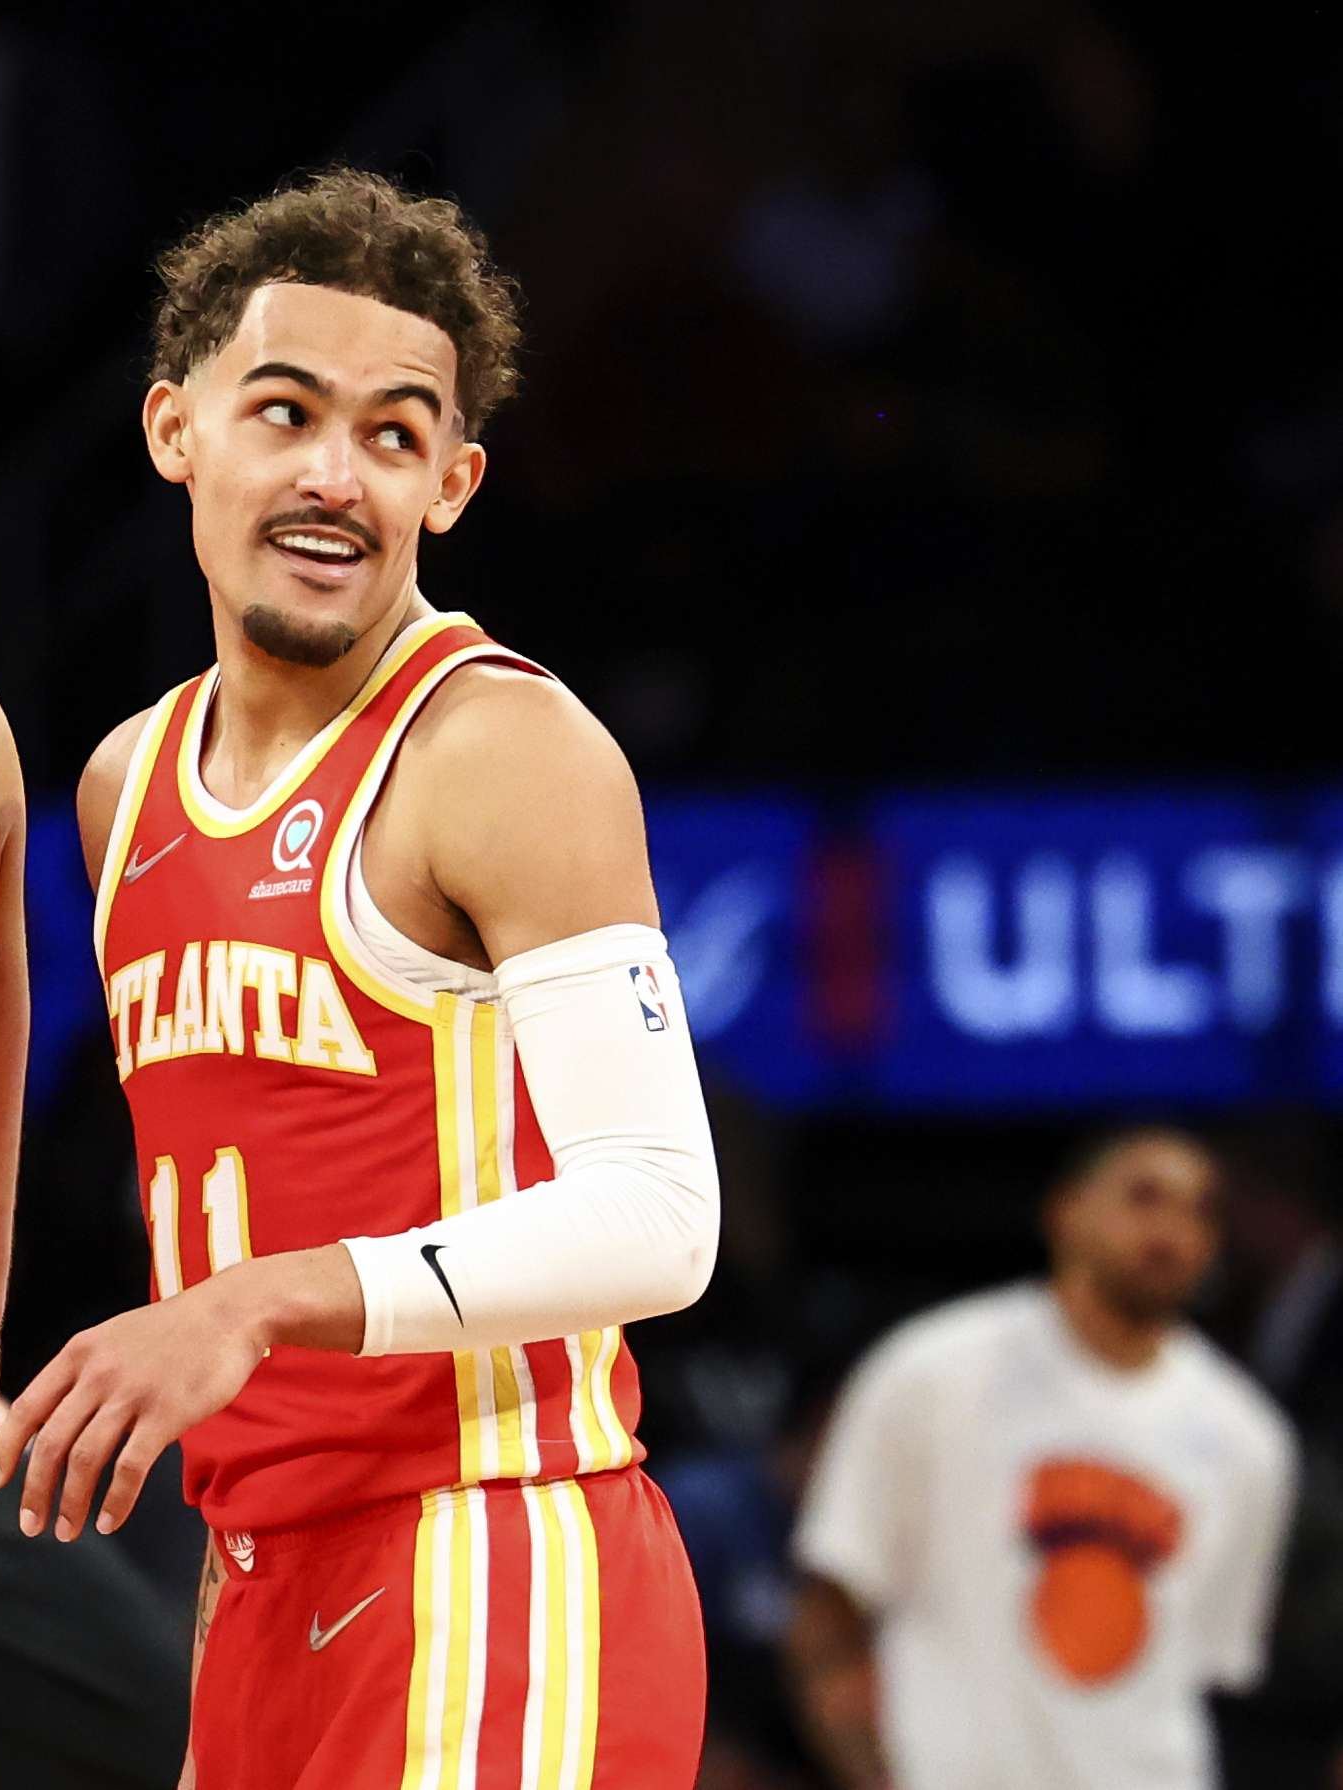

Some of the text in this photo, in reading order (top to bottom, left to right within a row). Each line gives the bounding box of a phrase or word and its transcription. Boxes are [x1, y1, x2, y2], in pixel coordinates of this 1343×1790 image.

[248, 878, 314, 899] sharecare
[105, 940, 378, 1084] TLANTA
[149, 1145, 254, 1301] 11
